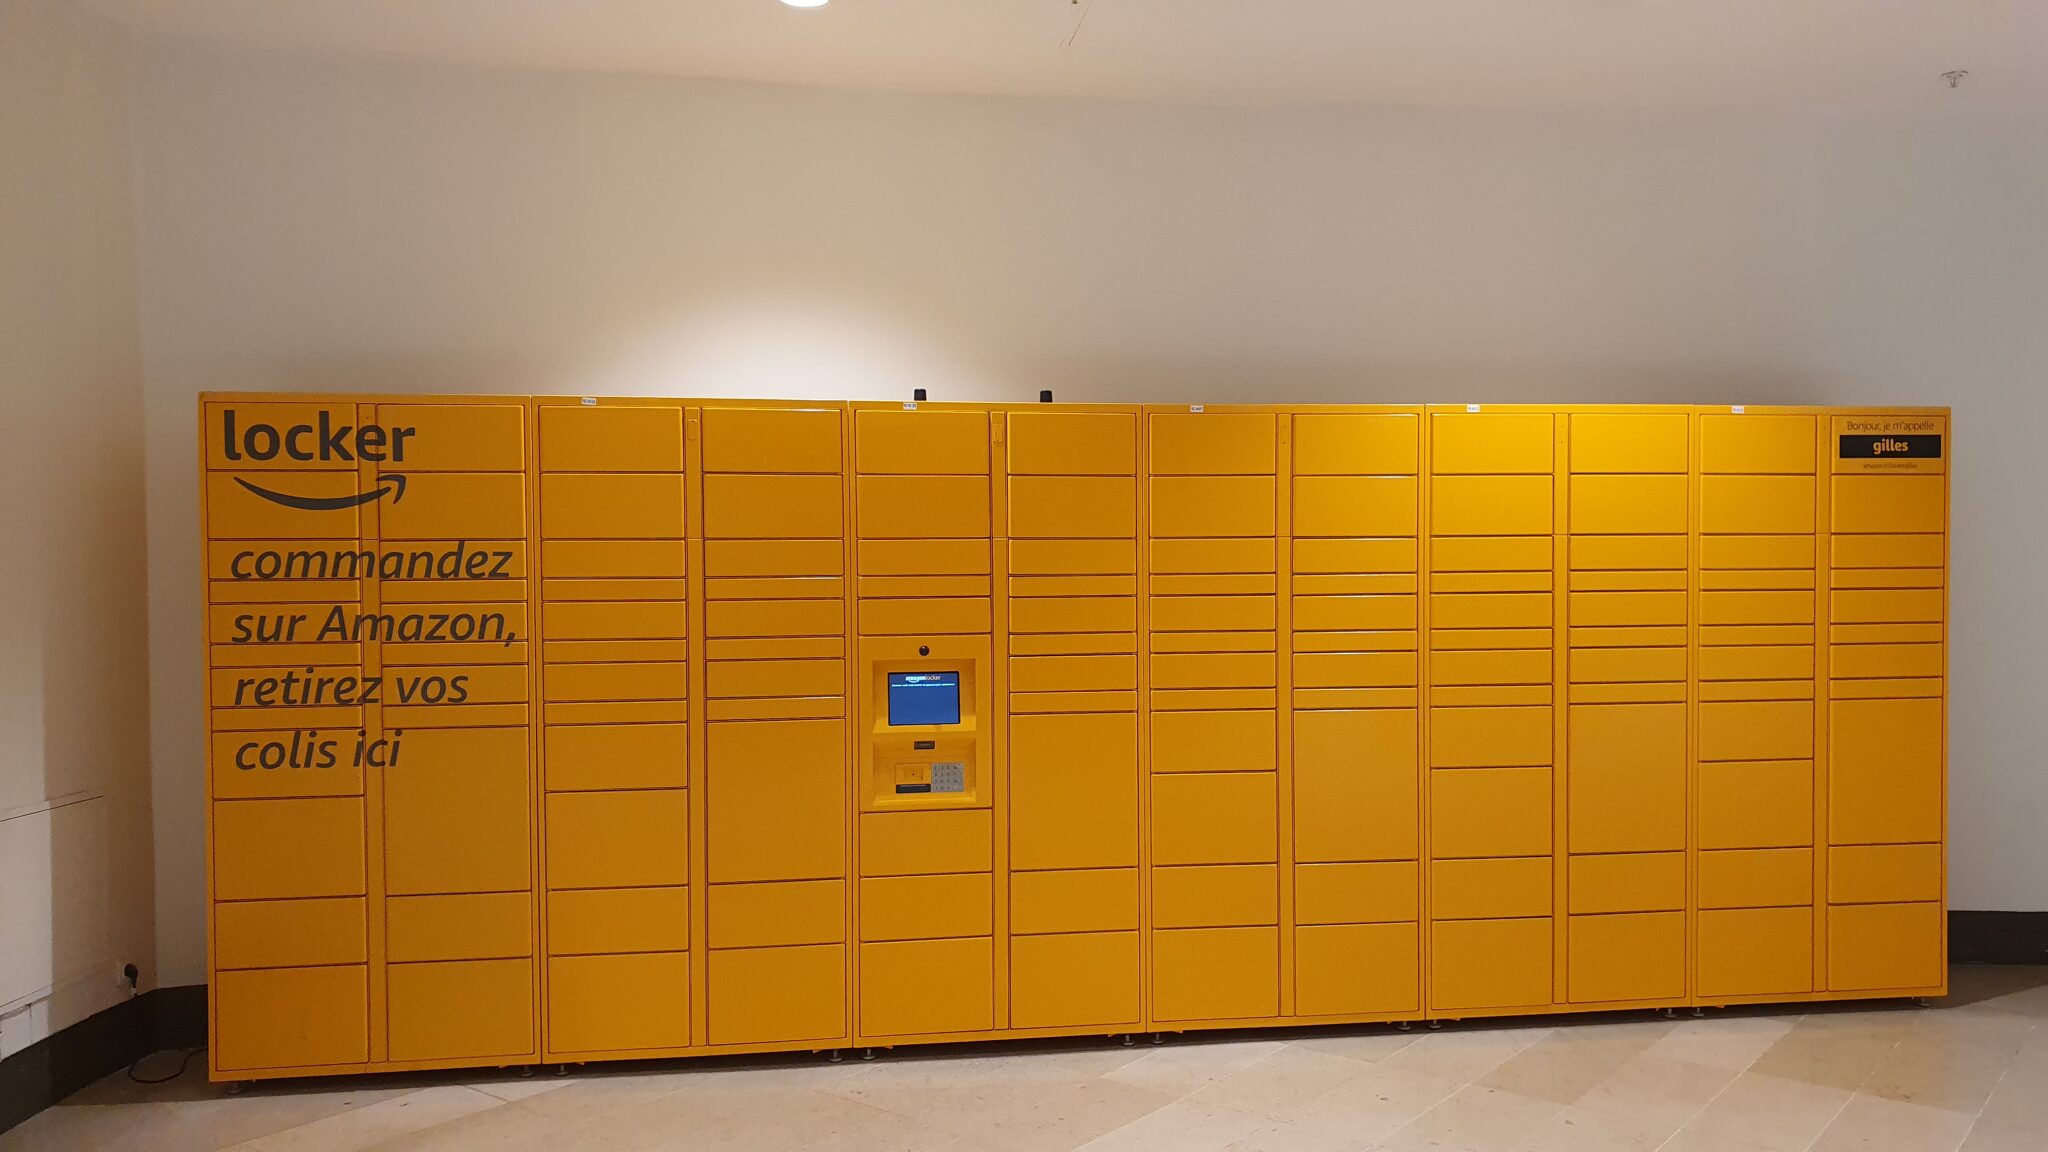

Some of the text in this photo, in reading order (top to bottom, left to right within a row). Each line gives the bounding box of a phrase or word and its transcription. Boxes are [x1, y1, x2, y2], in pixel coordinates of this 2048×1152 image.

[224, 410, 415, 461] locker
[1883, 421, 1891, 432] je
[1893, 420, 1934, 432] m'appelle
[1873, 438, 1908, 455] gilles
[231, 541, 514, 579] commandez
[232, 605, 516, 647] sur Amazon,
[234, 667, 469, 706] retirez vos
[235, 729, 401, 771] colis ici
